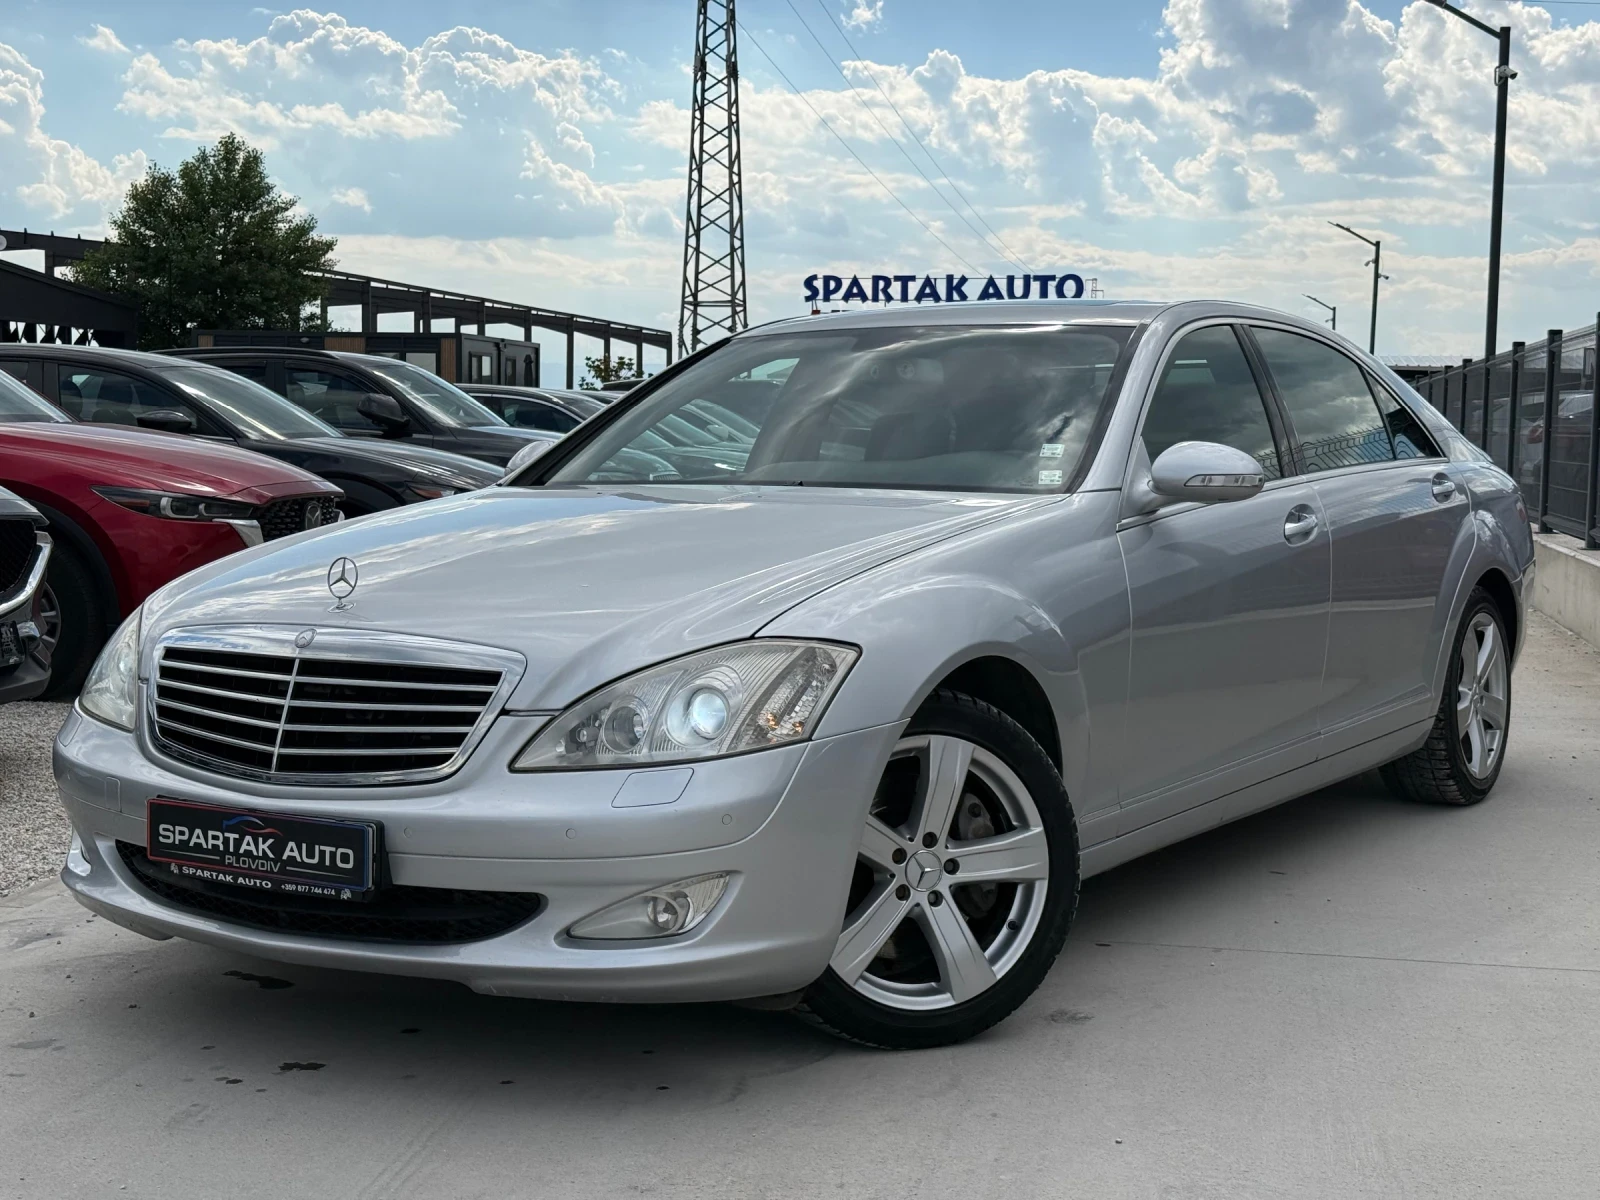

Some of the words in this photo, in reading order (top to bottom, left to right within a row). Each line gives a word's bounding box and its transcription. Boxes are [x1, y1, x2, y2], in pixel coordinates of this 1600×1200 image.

[803, 274, 969, 304] SPARTAK
[977, 273, 1085, 300] AUTO
[158, 823, 275, 859] SPARTAK
[282, 841, 354, 869] AUTO
[225, 854, 281, 873] PLOVDIV
[182, 865, 234, 883] SPARTAK
[237, 875, 272, 889] AUTO
[281, 883, 296, 891] +359
[310, 886, 323, 894] 744
[323, 887, 336, 896] 474
